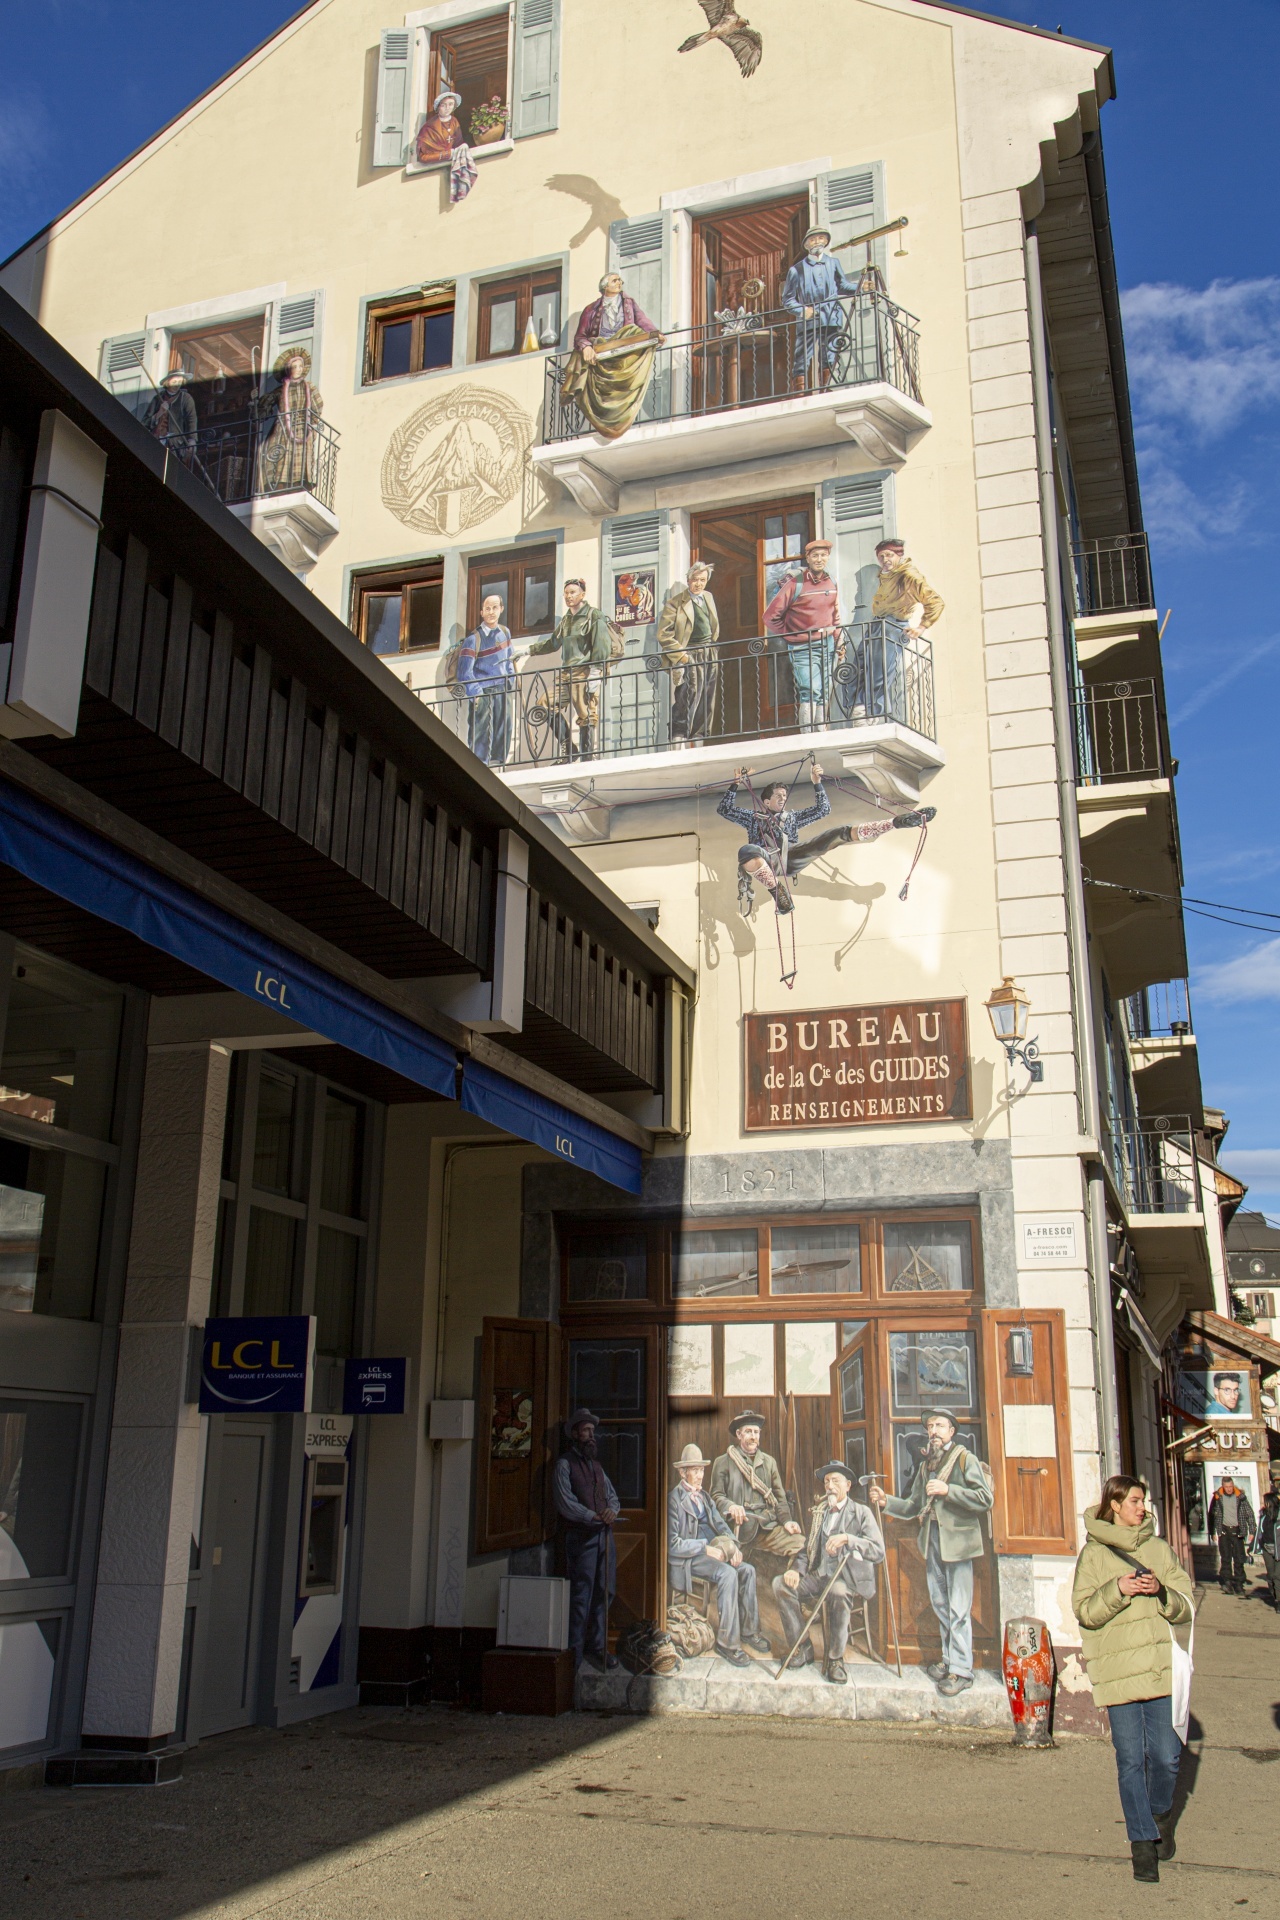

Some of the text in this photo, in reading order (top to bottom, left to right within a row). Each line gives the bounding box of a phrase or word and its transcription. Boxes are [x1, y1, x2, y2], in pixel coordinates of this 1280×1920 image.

[446, 404, 514, 448] CHAMONIX
[255, 970, 291, 1009] LCL
[767, 1011, 941, 1053] BUREAU
[763, 1054, 950, 1090] de la Cie des GUIDES
[769, 1094, 945, 1121] RENSEIGNEMENTS
[556, 1134, 576, 1159] LCL
[720, 1168, 798, 1194] 1821
[1026, 1226, 1073, 1236] A-FRESCO
[211, 1340, 295, 1370] LCL
[357, 1372, 392, 1380] EXPRESS
[320, 1418, 336, 1431] LCL
[306, 1433, 349, 1447] EXPRESS
